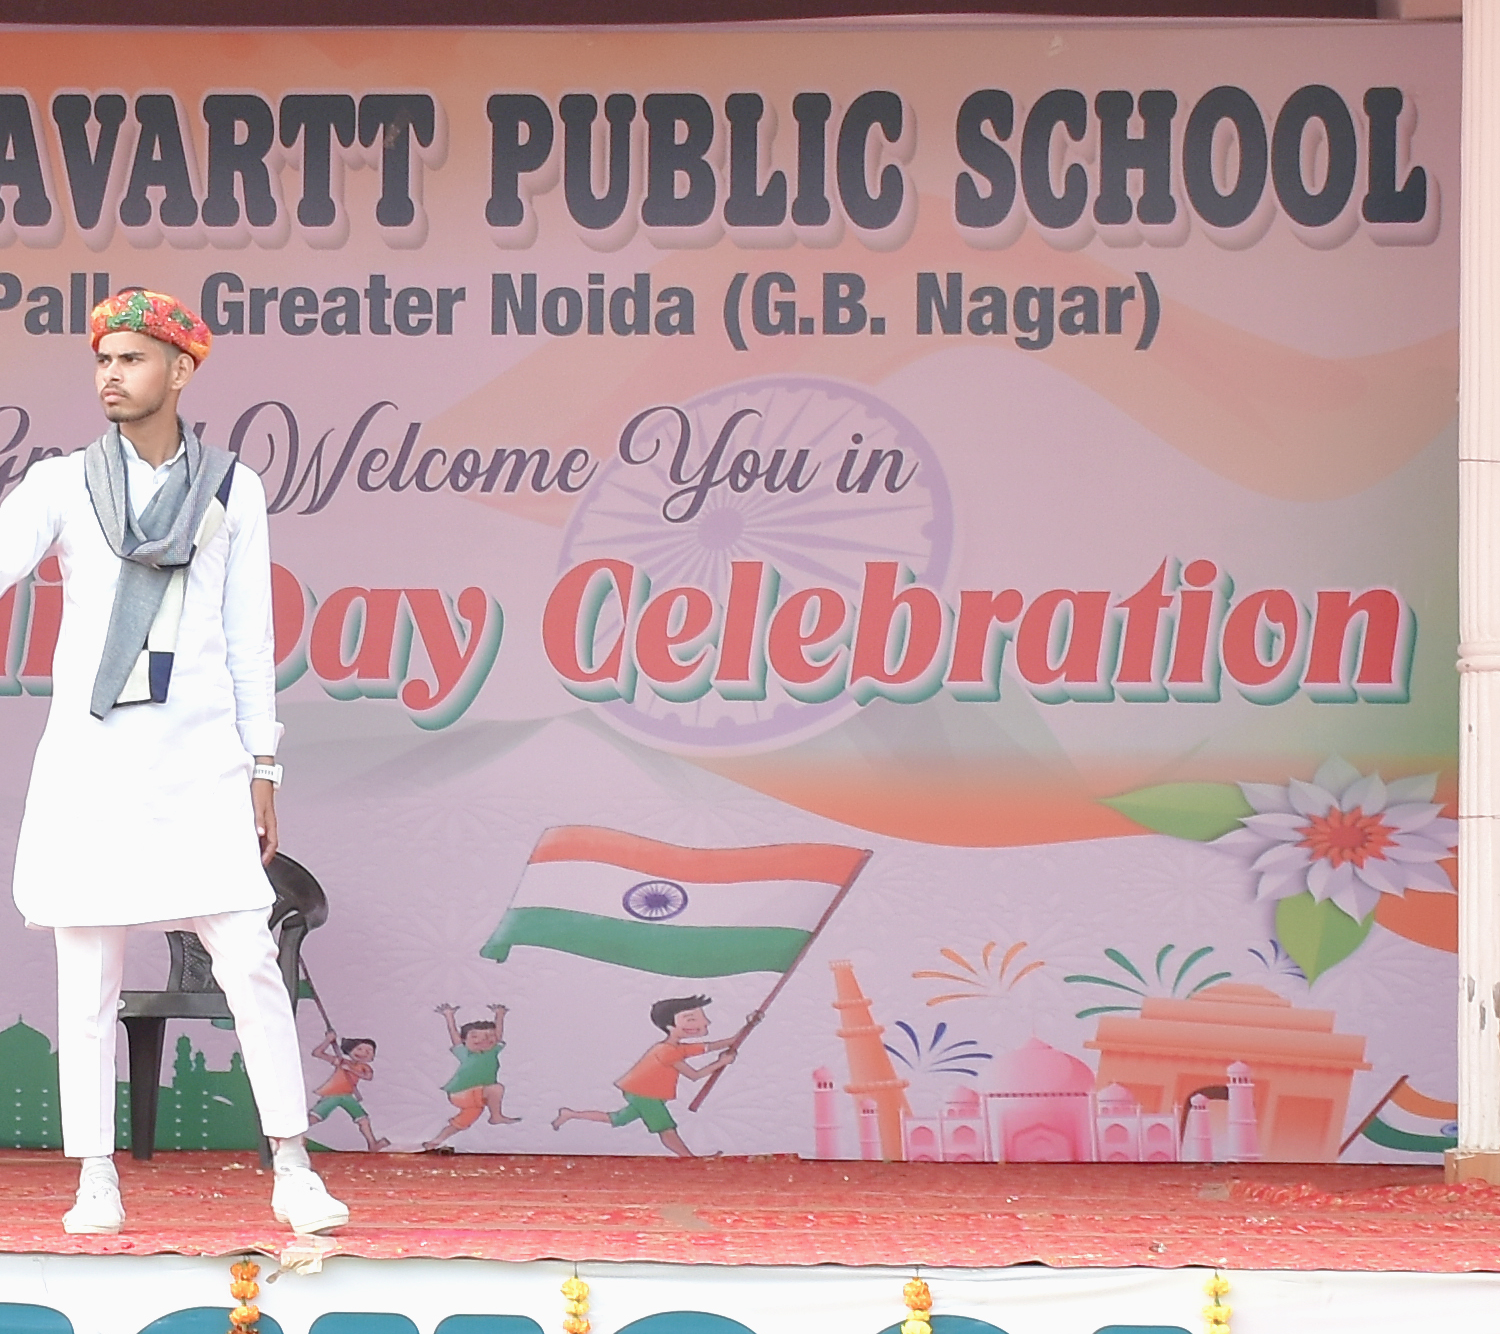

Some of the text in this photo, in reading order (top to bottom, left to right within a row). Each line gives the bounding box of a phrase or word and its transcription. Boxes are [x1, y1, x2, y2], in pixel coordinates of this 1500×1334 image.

[486, 91, 904, 229] PUBLIC
[954, 85, 1428, 228] SCHOOL
[201, 271, 467, 337] Greater
[492, 271, 696, 337] Noida
[724, 272, 886, 352] (G.B.
[916, 271, 1162, 352] Nagar)
[228, 399, 599, 517] Welcome
[616, 404, 827, 523] You
[835, 432, 917, 496] in
[541, 553, 1400, 687] Celebration
